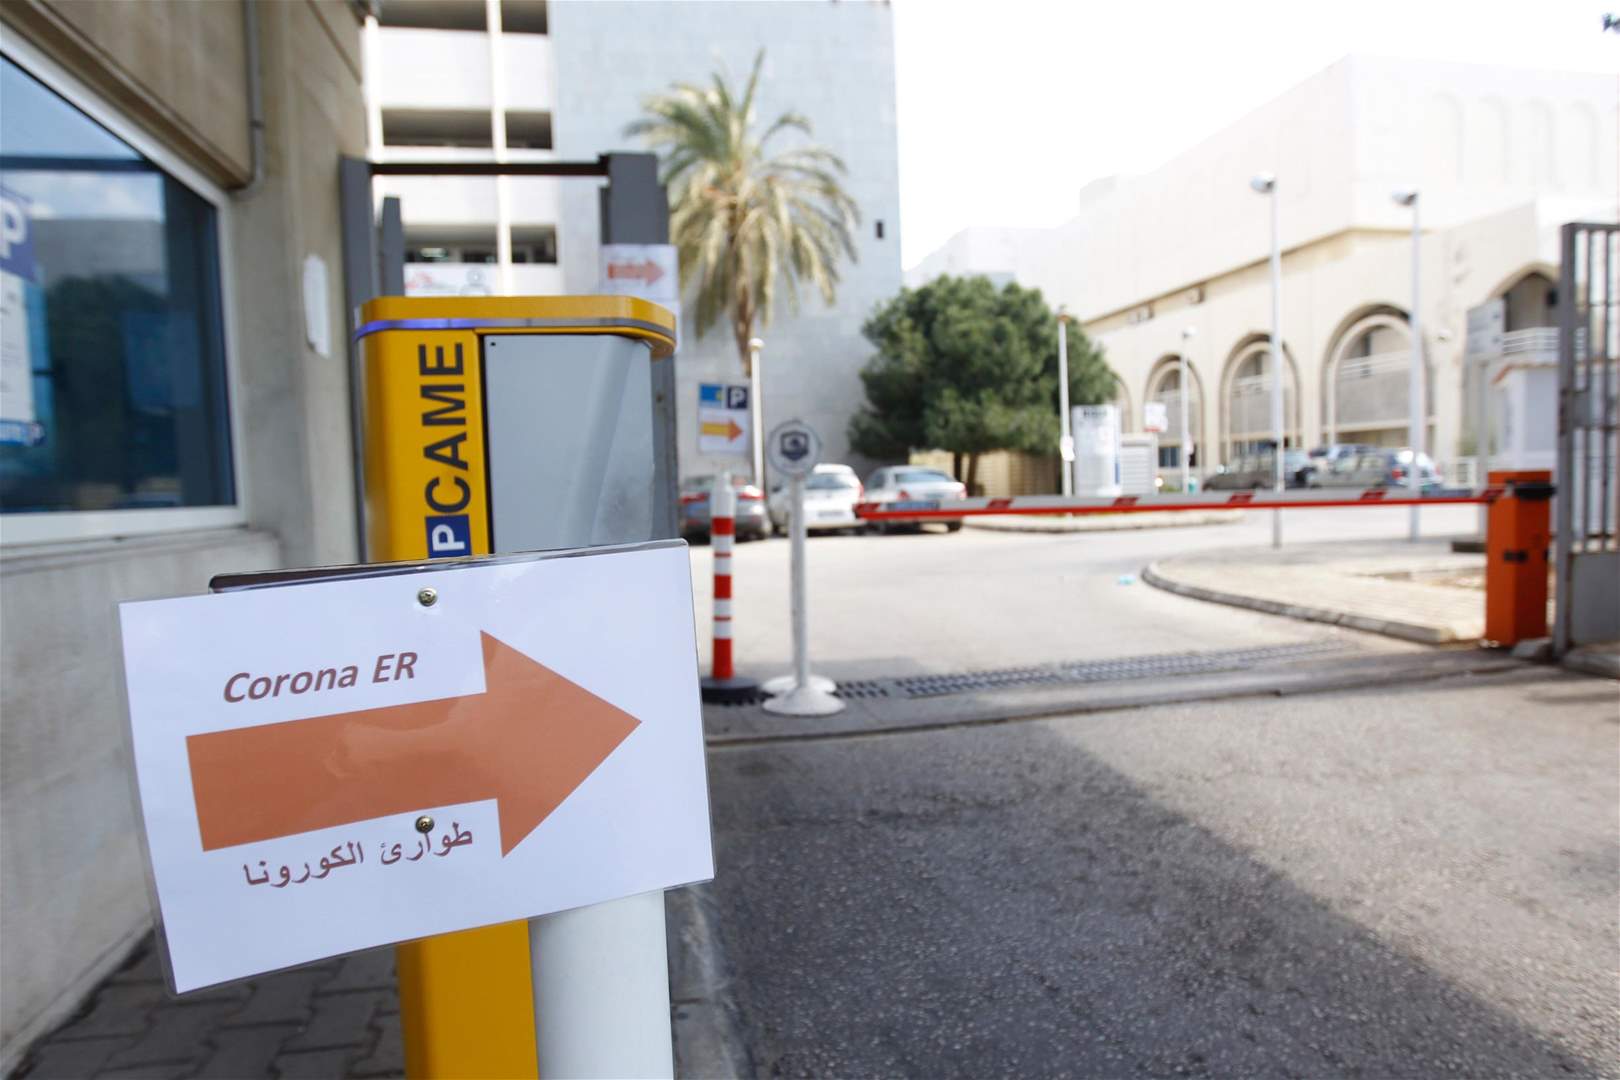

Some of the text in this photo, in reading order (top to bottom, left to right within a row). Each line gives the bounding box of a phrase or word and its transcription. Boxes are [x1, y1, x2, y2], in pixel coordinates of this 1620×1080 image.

[731, 388, 744, 408] P
[223, 651, 418, 703] Corona ER
[243, 821, 473, 888] طوارئ الكورونا
